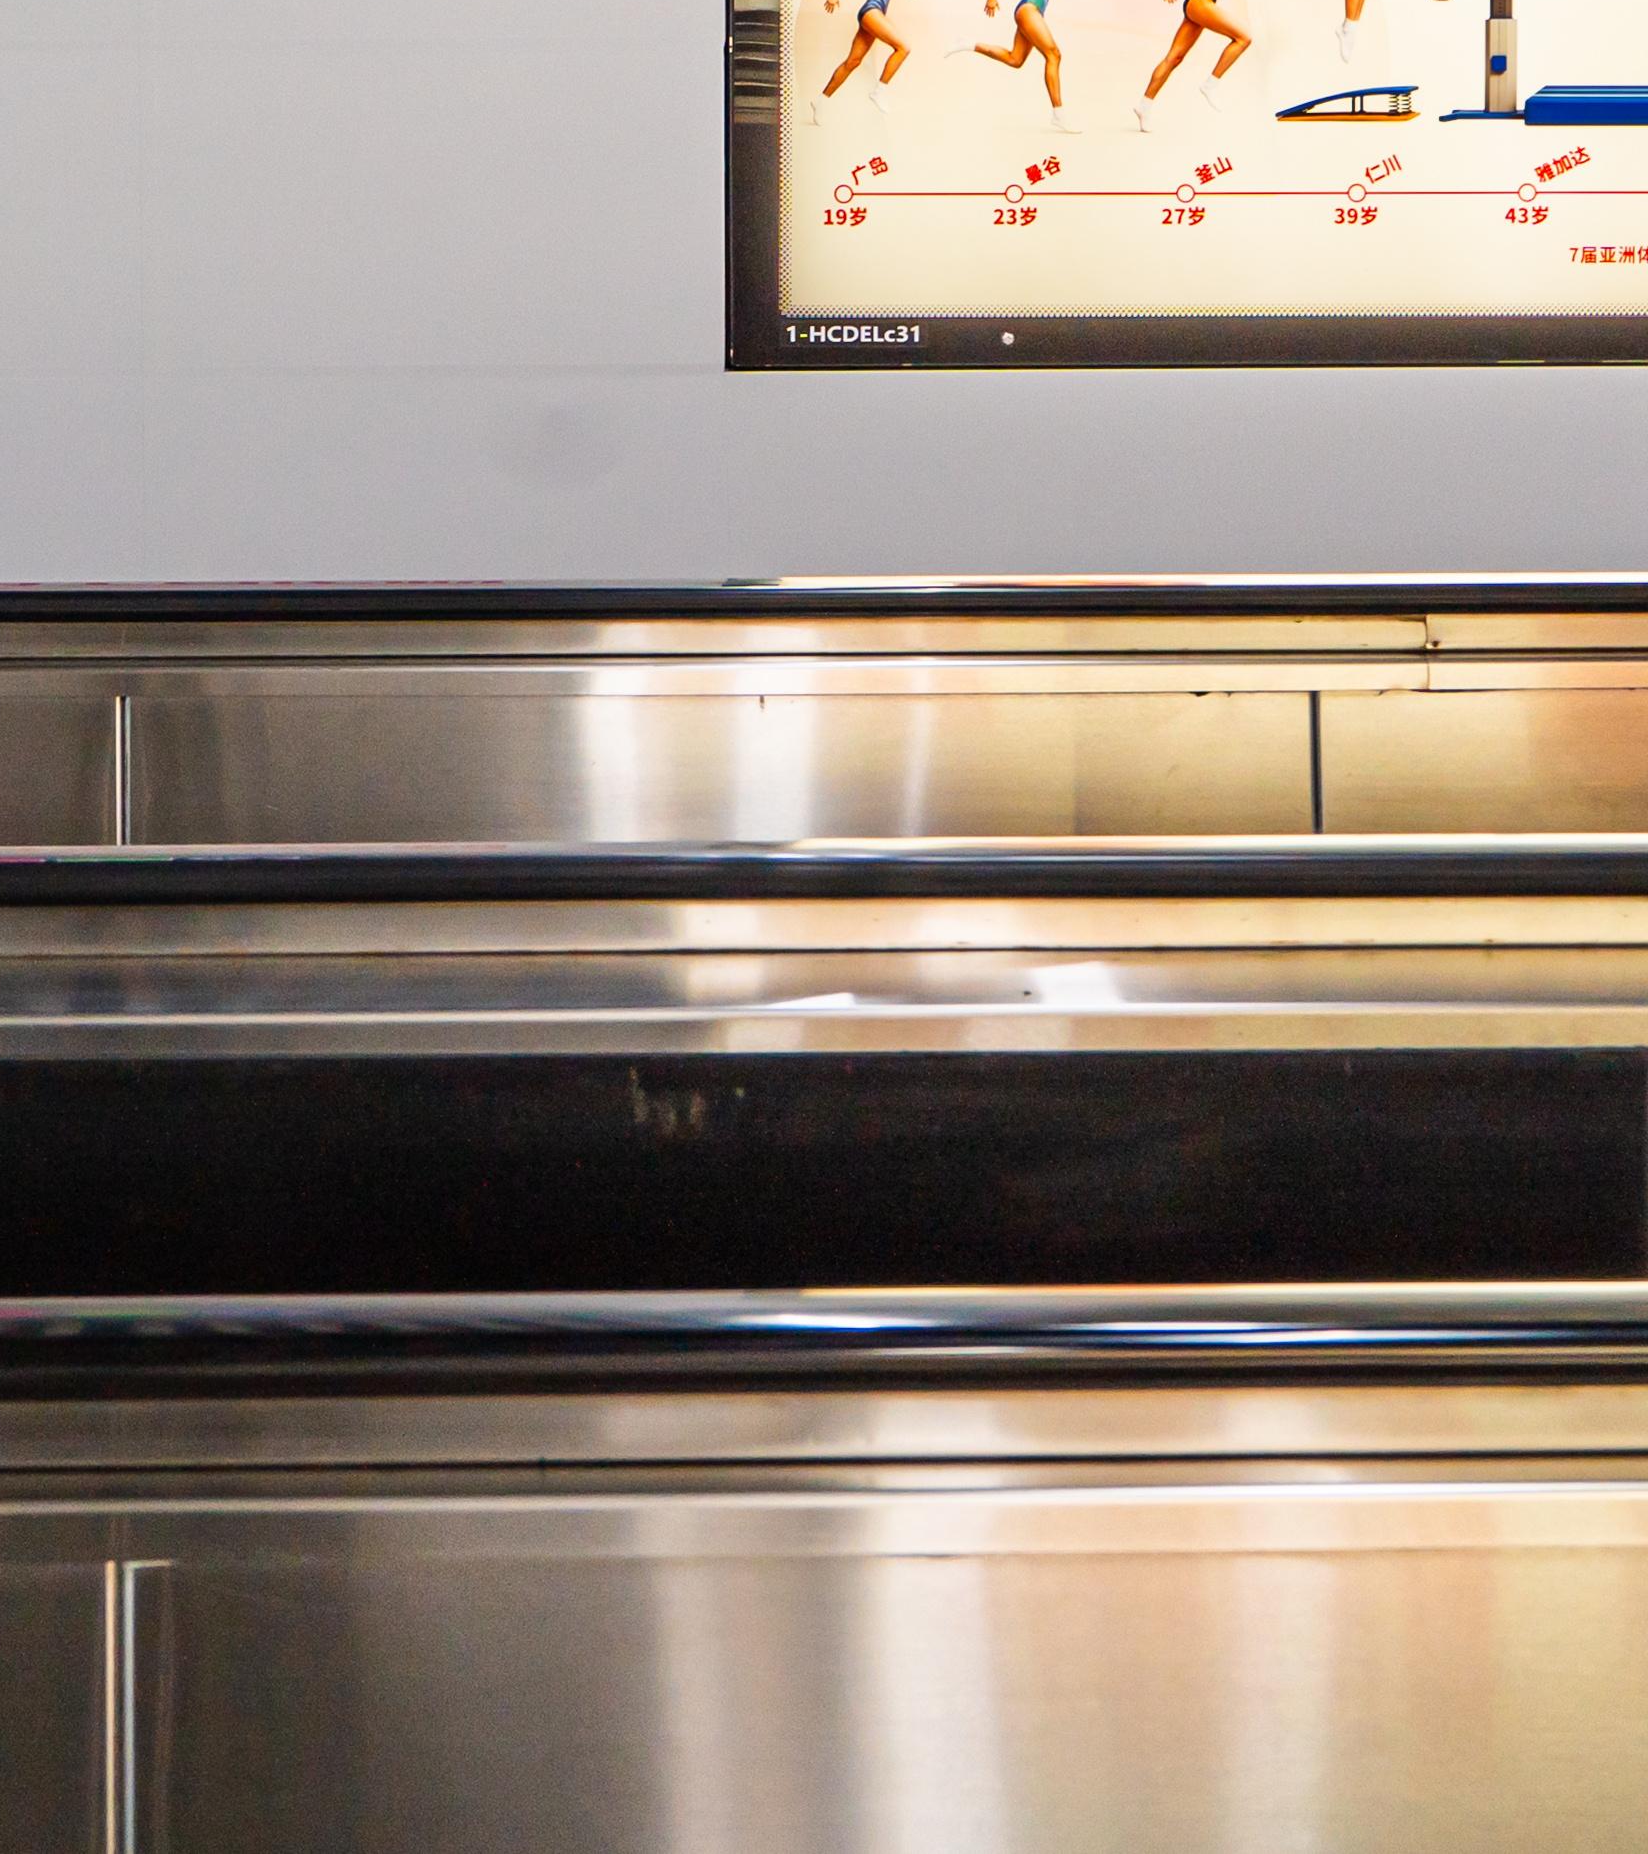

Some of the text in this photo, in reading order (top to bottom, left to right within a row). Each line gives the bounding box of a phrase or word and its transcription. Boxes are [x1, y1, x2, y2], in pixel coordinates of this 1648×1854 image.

[851, 154, 891, 187] 广岛
[1024, 154, 1064, 187] 曼谷
[1195, 154, 1235, 187] 釜山
[1365, 154, 1404, 185] 仁川
[1535, 146, 1592, 185] 雅加达
[823, 208, 868, 228] 19岁
[993, 208, 1038, 228] 23岁
[1161, 208, 1206, 228] 27岁
[1334, 207, 1378, 227] 39岁
[1505, 206, 1549, 226] 43岁
[786, 326, 921, 344] 1-HCDELc31
